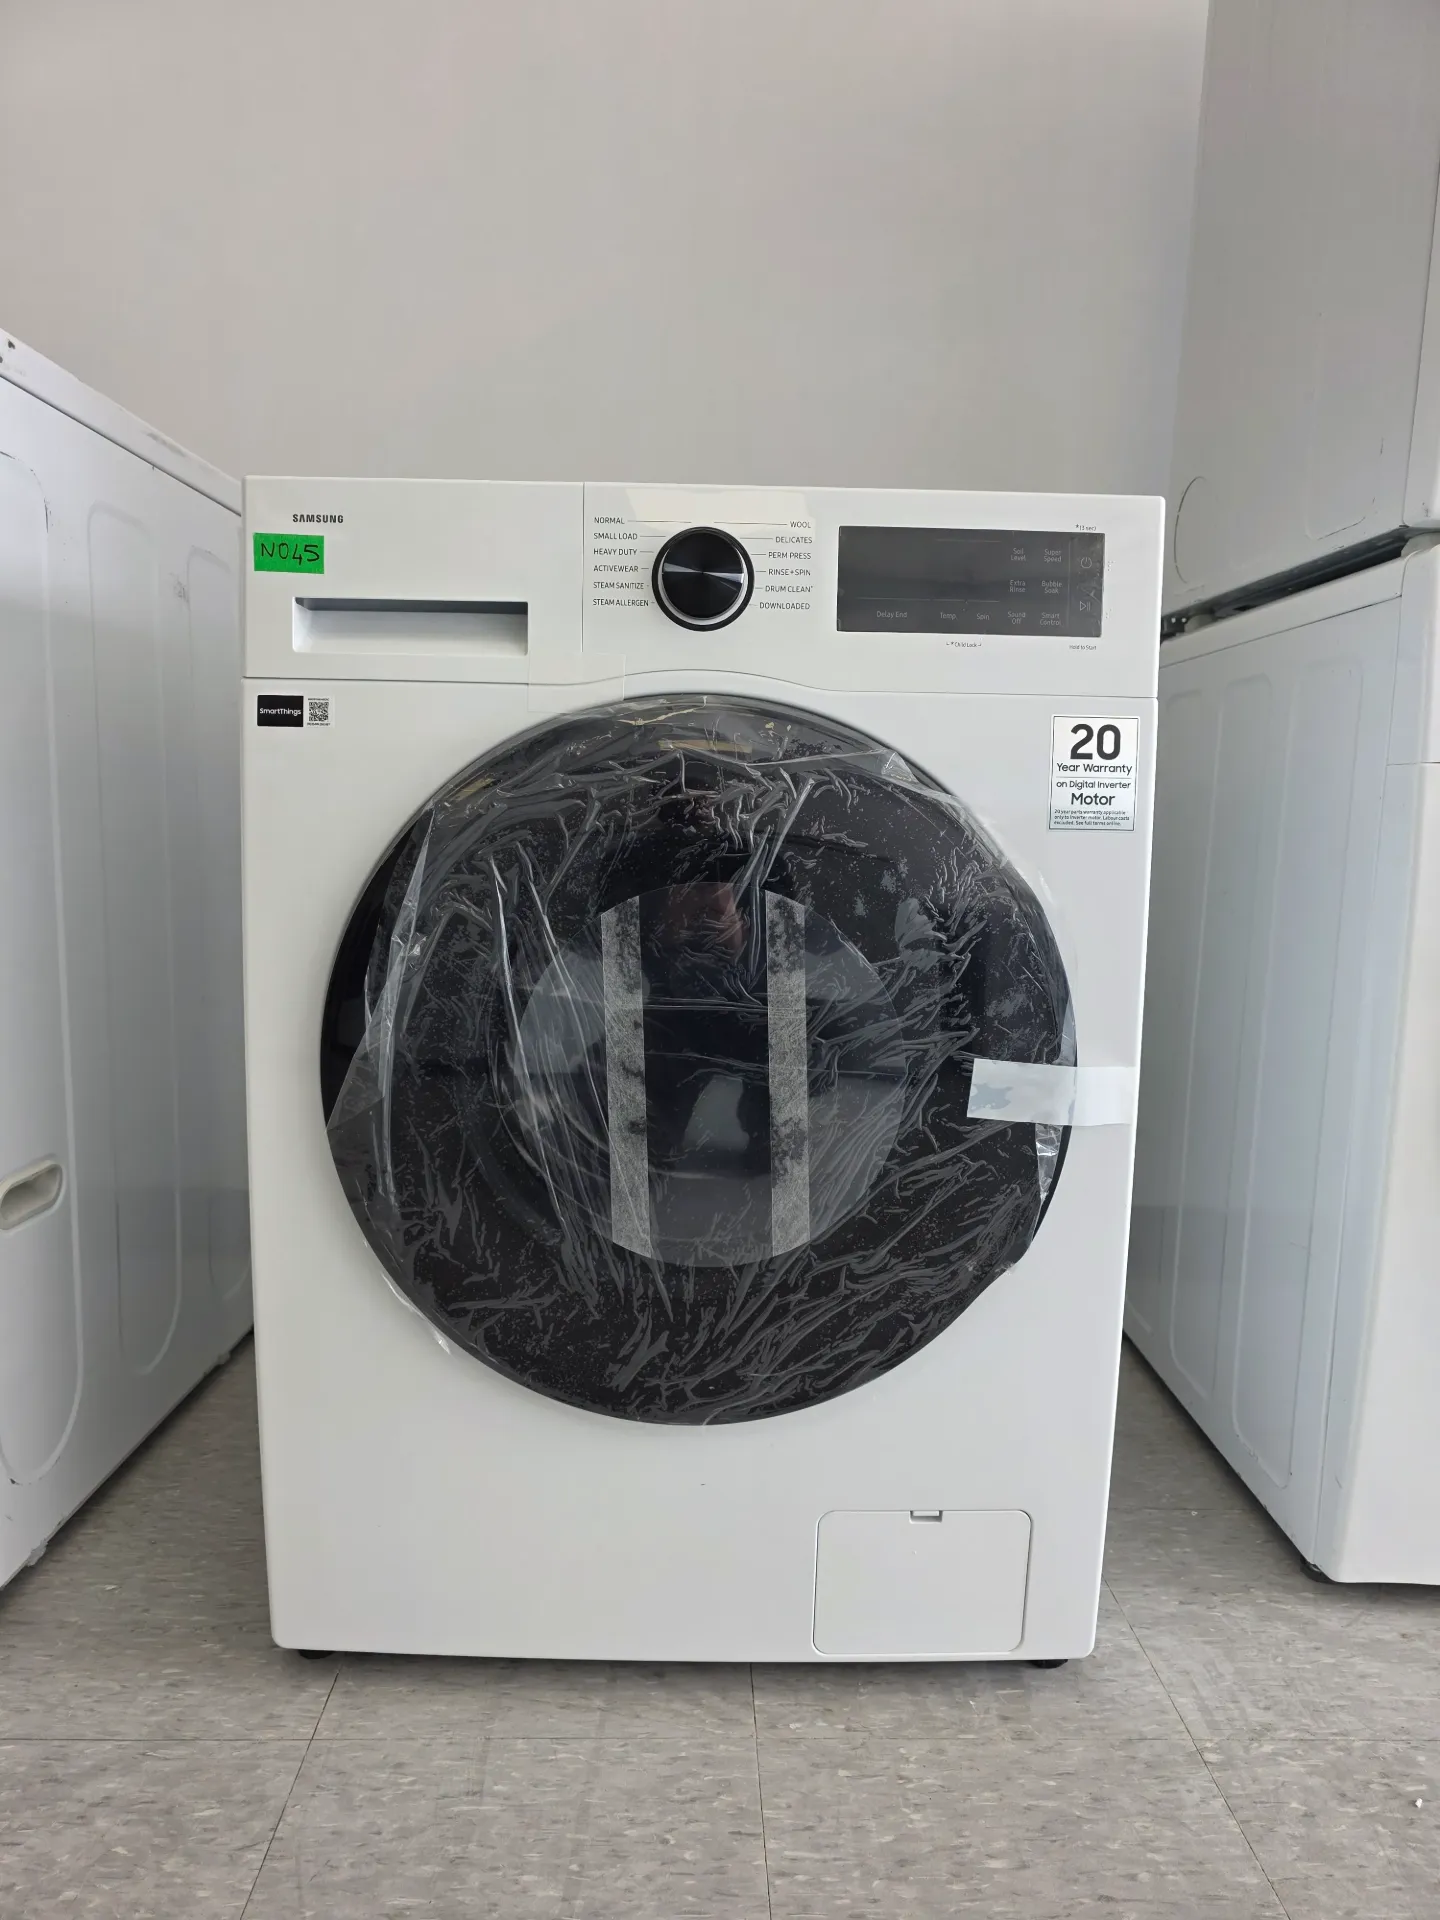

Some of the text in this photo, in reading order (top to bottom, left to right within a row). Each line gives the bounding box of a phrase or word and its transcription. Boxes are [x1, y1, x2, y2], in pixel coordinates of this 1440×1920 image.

[292, 514, 344, 523] SAMSUNG
[876, 610, 893, 619] Delay
[260, 708, 301, 716] SmartThings
[1070, 724, 1121, 760] 20
[1057, 763, 1132, 776] Year Warranty
[1069, 780, 1095, 790] Digital
[1071, 792, 1116, 806] Motor
